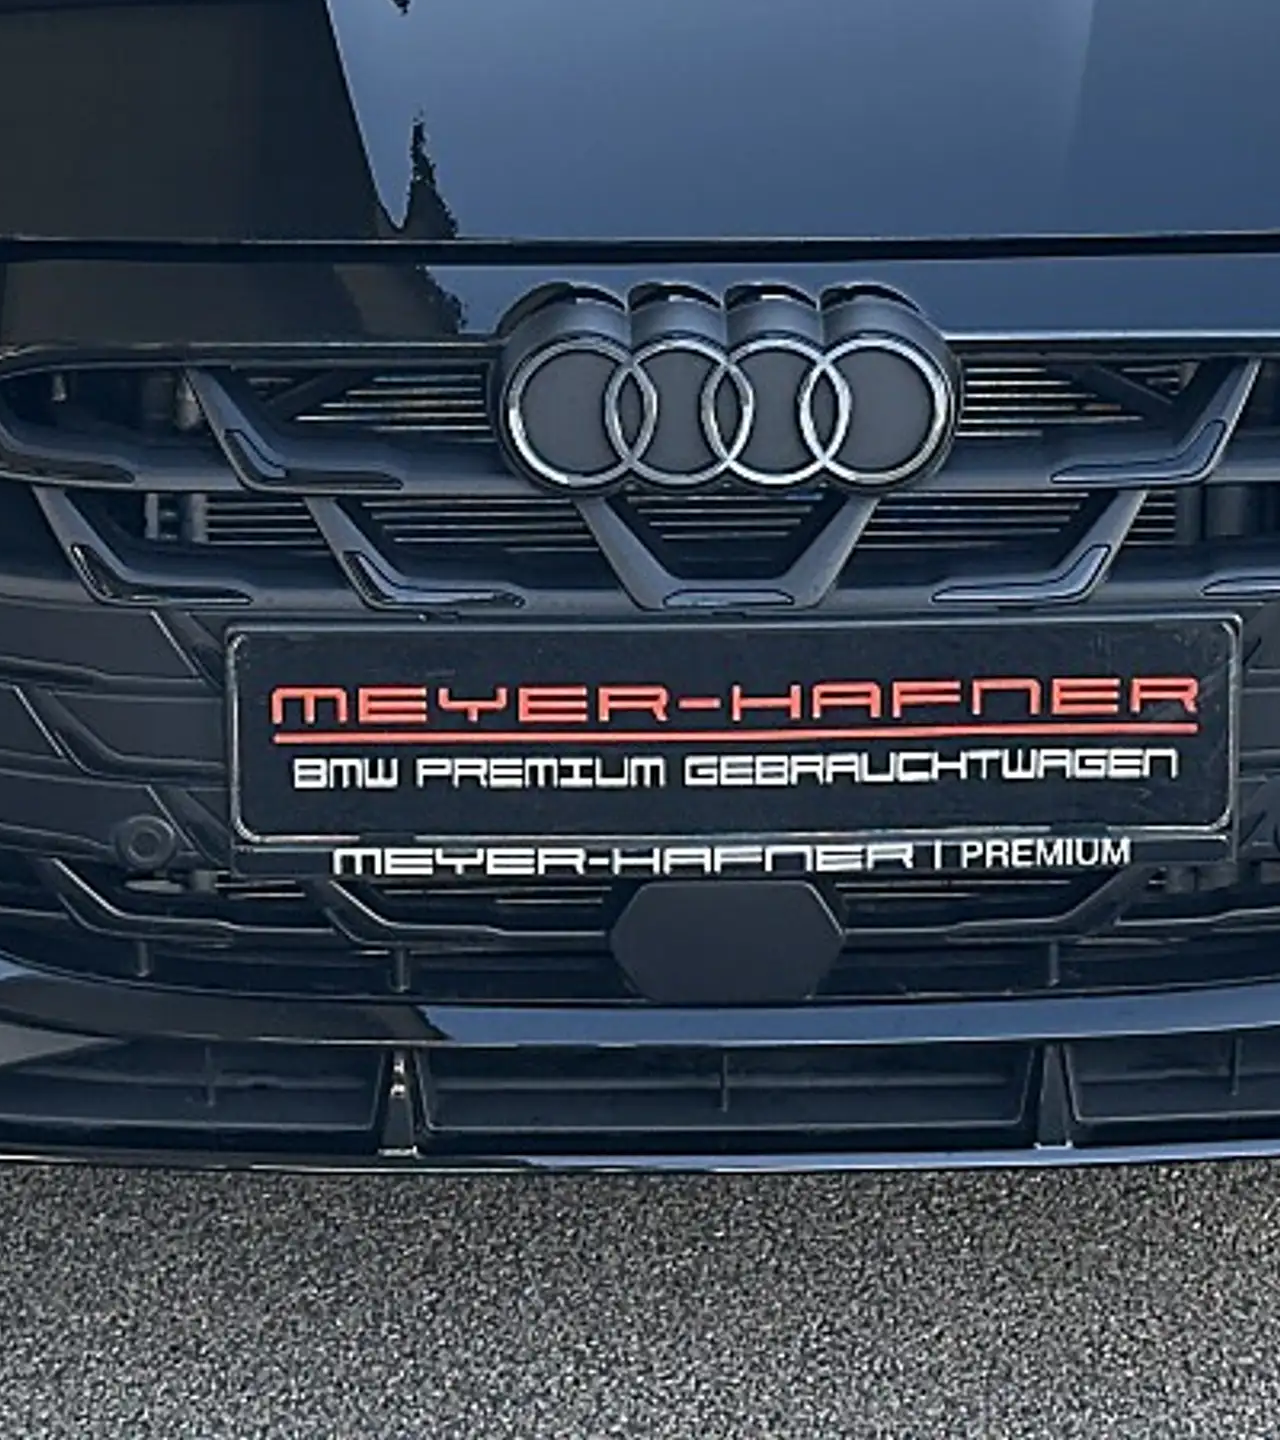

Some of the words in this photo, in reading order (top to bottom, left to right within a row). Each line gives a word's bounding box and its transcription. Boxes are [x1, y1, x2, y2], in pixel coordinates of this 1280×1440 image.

[271, 677, 1200, 725] MEYER-HAFNER
[293, 757, 399, 790] BMW
[415, 755, 666, 788] PREMIUM
[684, 747, 1179, 786] GEBRAUCHTWAGEN
[332, 842, 914, 876] MEYER-HAFNER
[961, 837, 1132, 869] PREMIUM
